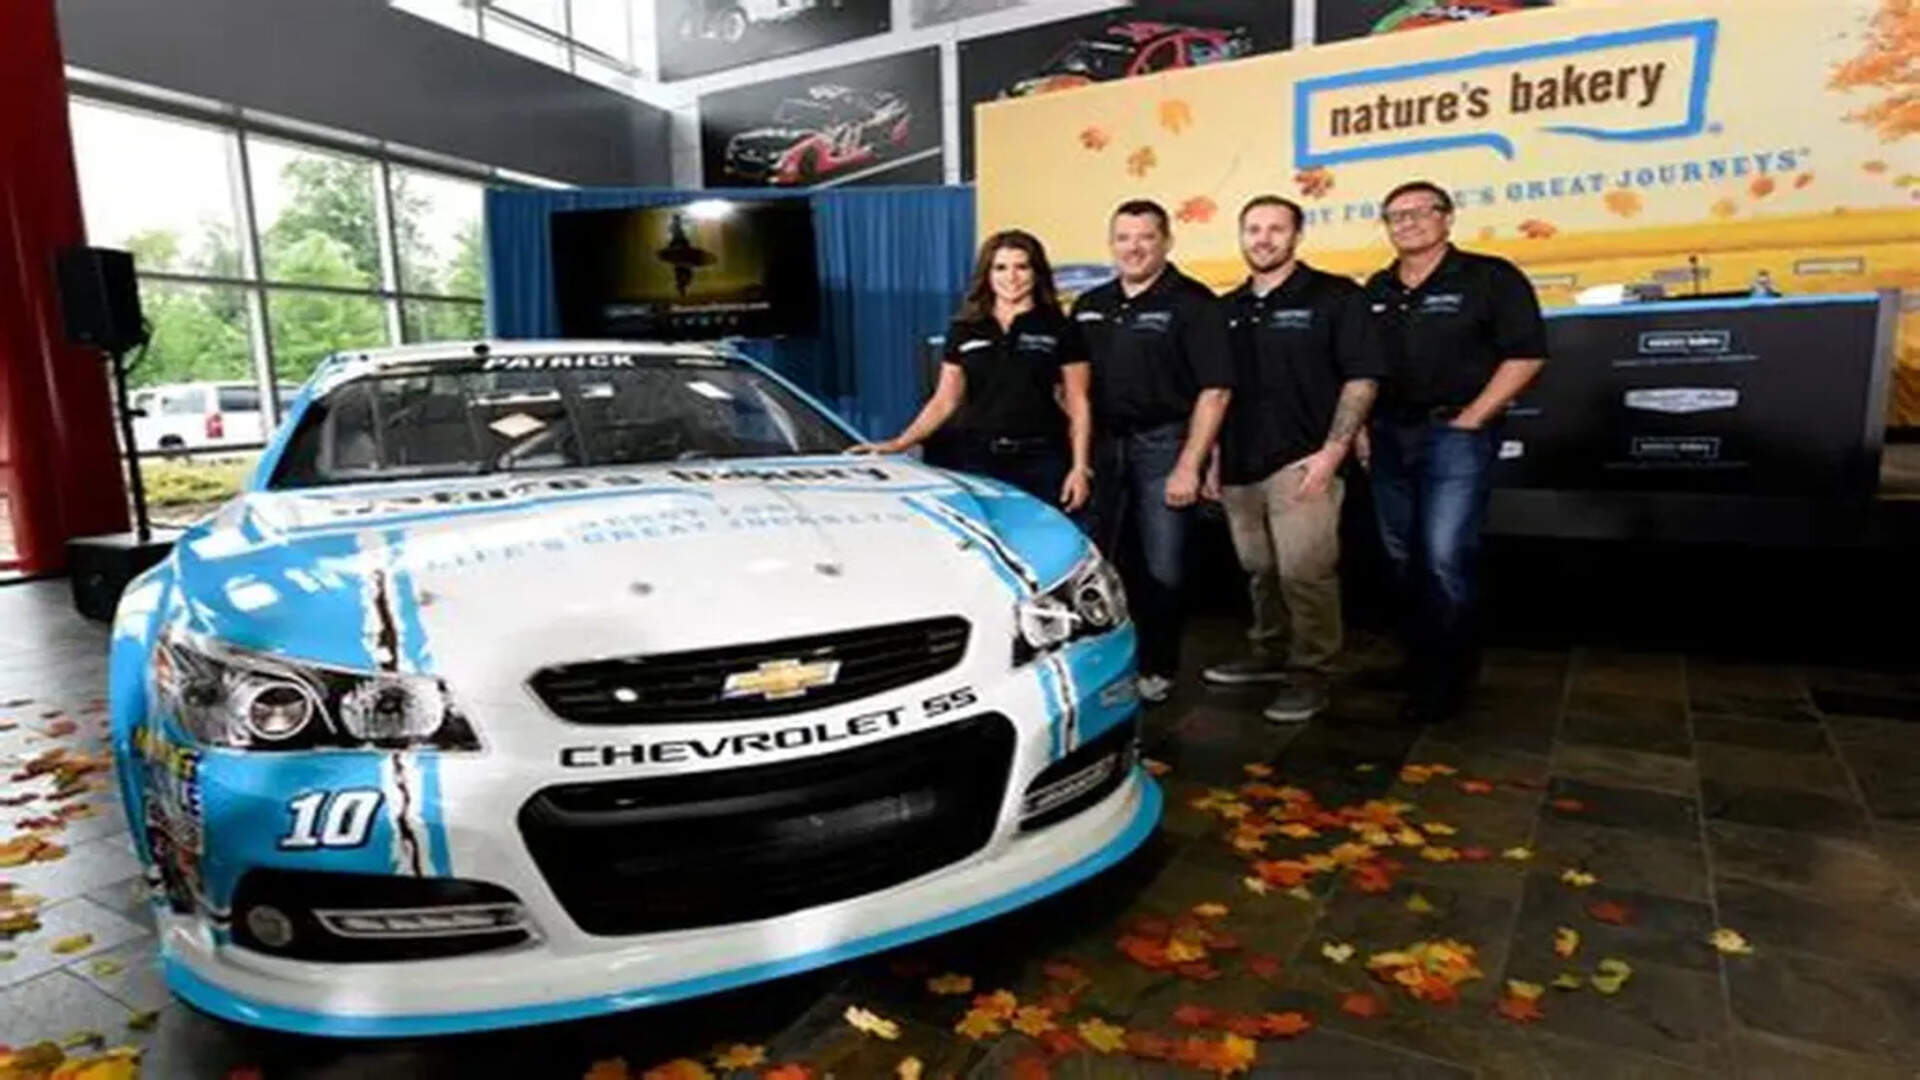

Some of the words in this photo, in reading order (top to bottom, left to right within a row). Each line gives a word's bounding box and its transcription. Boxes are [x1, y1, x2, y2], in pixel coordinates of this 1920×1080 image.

[1329, 83, 1490, 138] nature's
[1509, 61, 1667, 115] bakery
[1506, 173, 1604, 202] GREAT
[482, 354, 635, 370] PATRICK
[559, 705, 905, 768] CHEVROLET
[276, 787, 384, 852] 10
